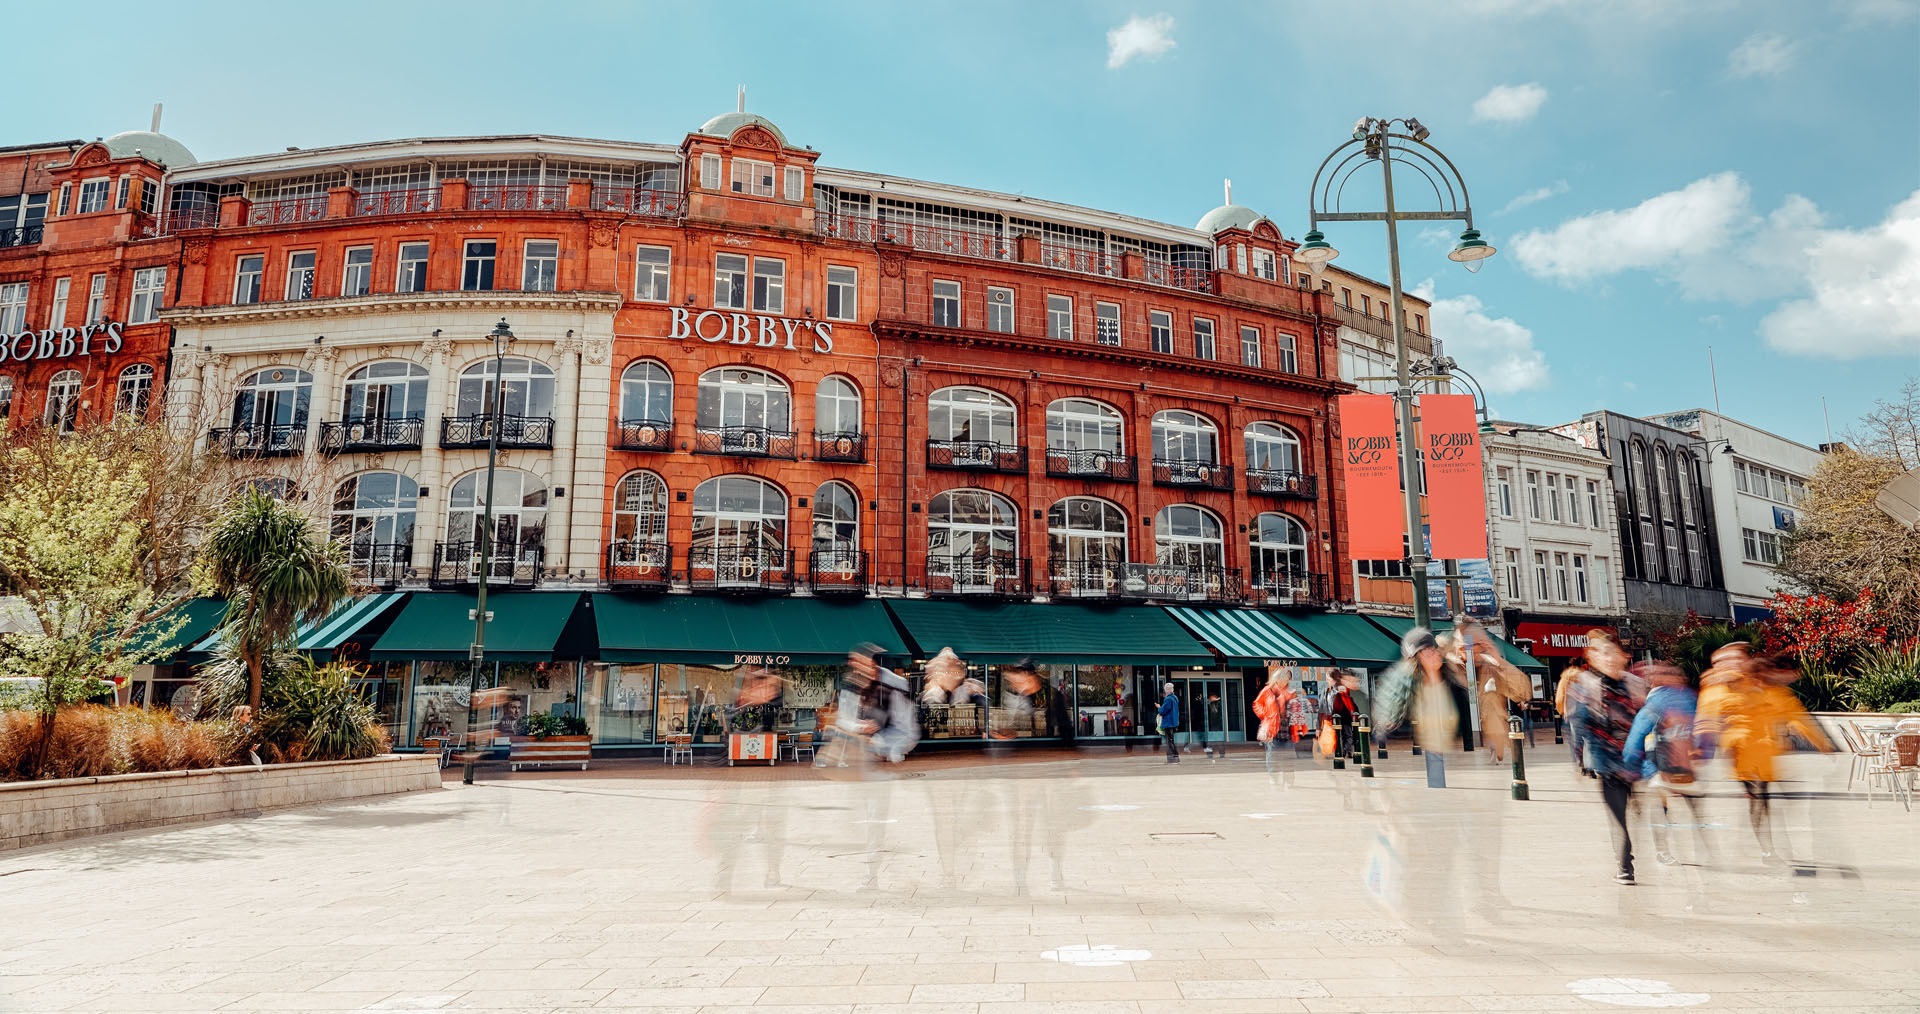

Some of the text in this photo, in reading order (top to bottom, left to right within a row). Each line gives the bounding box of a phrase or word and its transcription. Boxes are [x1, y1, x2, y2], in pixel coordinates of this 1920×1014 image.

[668, 306, 834, 353] BOBBY'S
[0, 321, 125, 362] BOBBY'S
[745, 432, 757, 450] B
[841, 437, 851, 455] B
[1348, 436, 1392, 450] BOBBY
[1431, 433, 1475, 447] BOBBY
[638, 553, 650, 575] B
[742, 556, 755, 577] B
[841, 560, 853, 581] B
[986, 564, 997, 585] B
[1105, 569, 1115, 588] B
[1147, 575, 1166, 585] NOW
[1551, 634, 1564, 647] PRET
[1565, 634, 1570, 647] A
[734, 654, 763, 664] BOBBY
[765, 655, 774, 664] &
